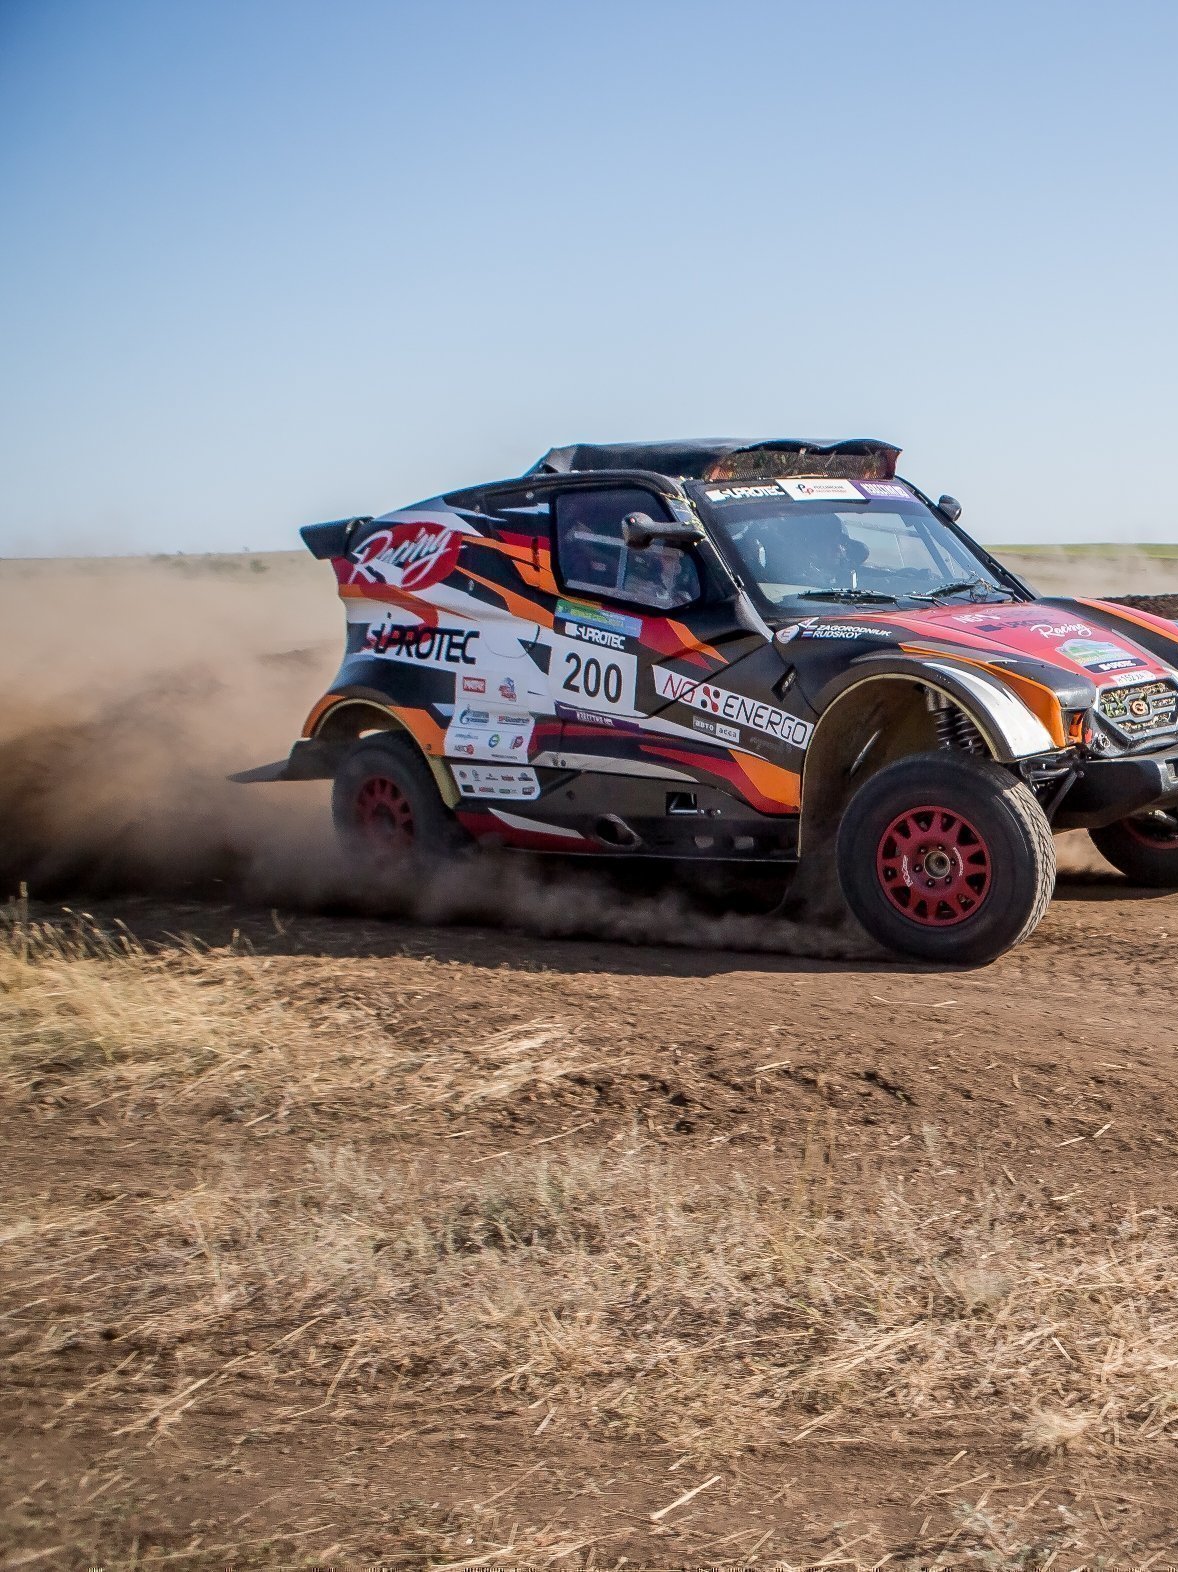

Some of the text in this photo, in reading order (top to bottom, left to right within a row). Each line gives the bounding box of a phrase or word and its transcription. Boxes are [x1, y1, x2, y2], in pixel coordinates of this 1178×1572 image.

[346, 527, 467, 588] Racing
[576, 624, 626, 650] SUPROTEC
[812, 630, 862, 639] RUDSKOY
[816, 625, 892, 637] ZAGORODNIUK
[1029, 623, 1094, 639] Racing
[562, 652, 623, 704] 200
[722, 694, 808, 745] ENERGO
